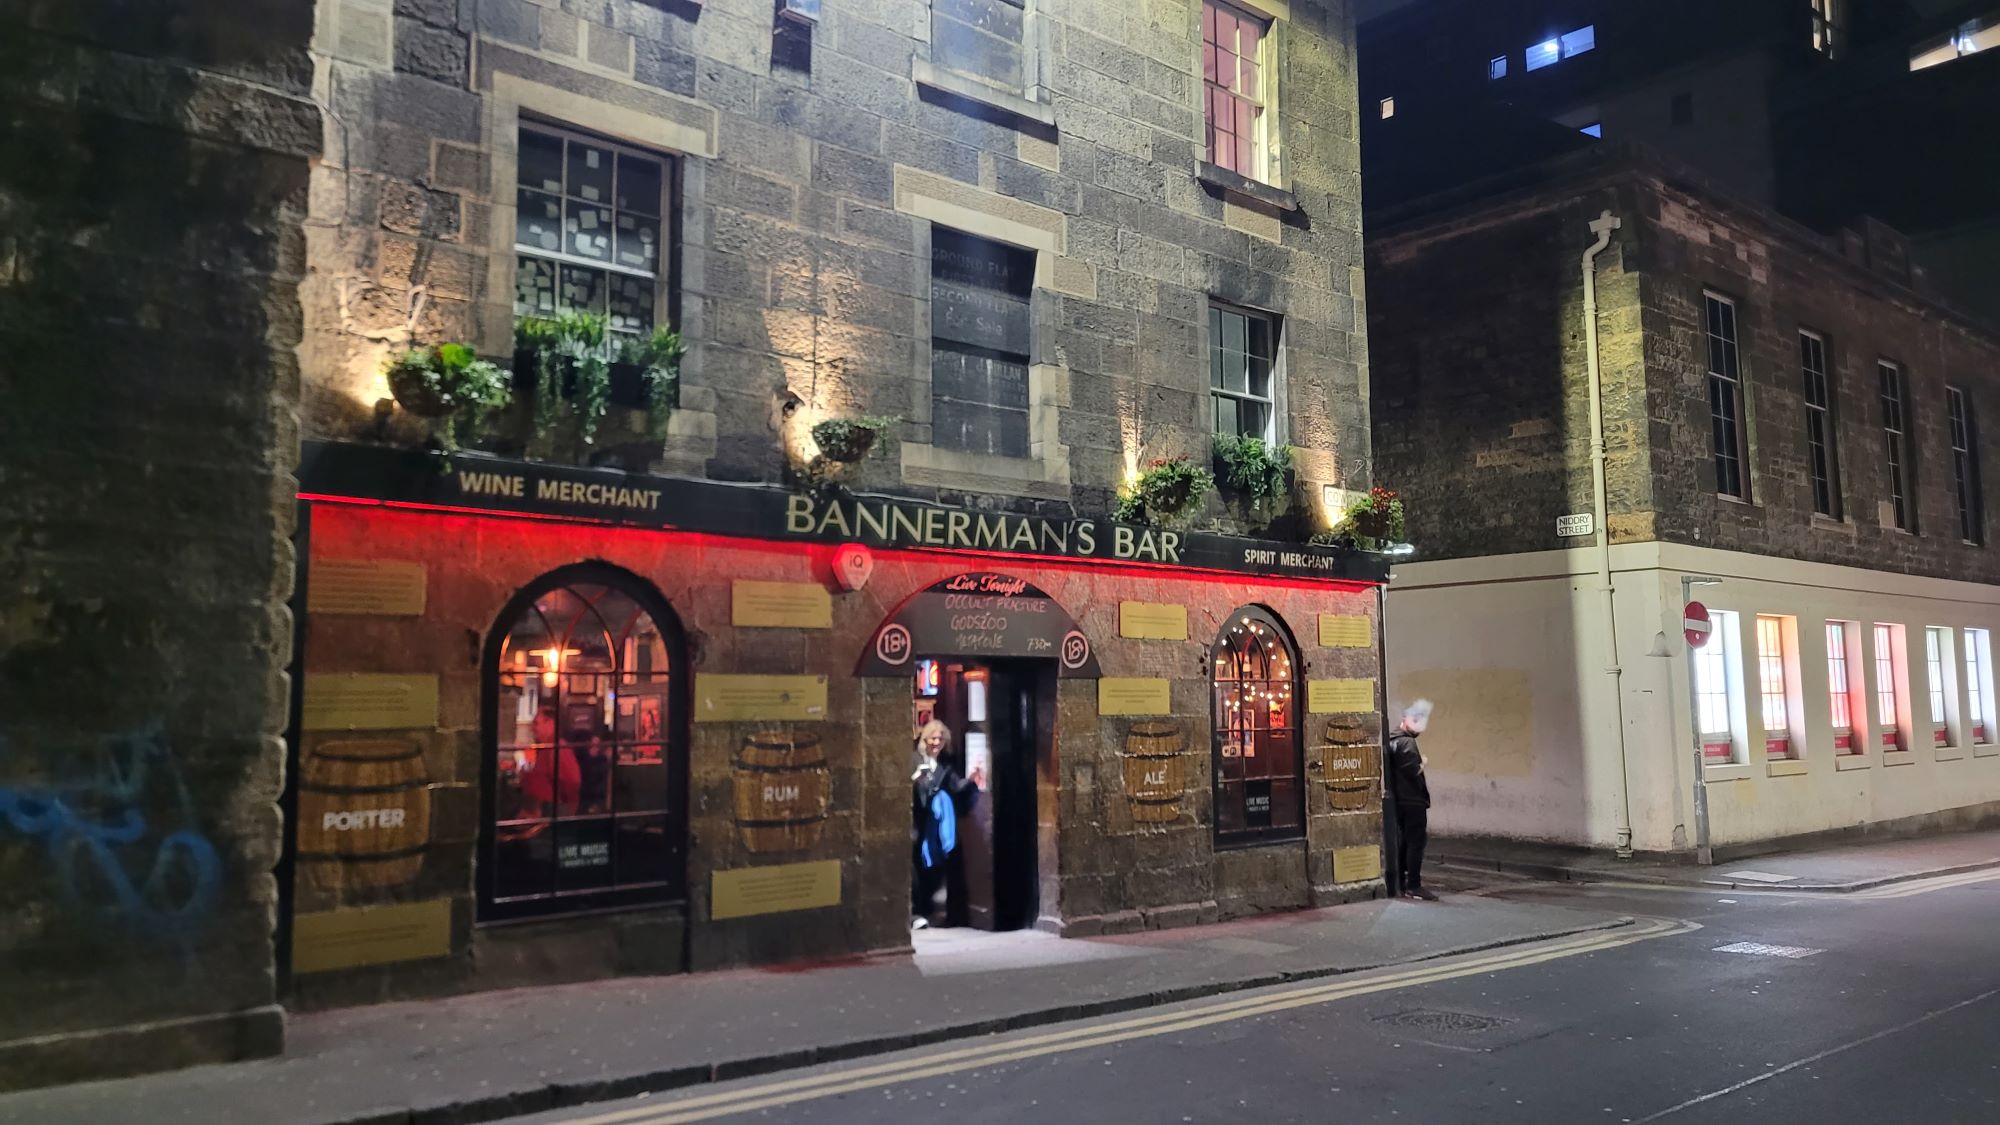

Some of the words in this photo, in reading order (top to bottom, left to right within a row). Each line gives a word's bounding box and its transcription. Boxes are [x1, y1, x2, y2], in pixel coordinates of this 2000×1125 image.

[460, 471, 525, 497] WINE
[538, 479, 661, 511] MERCHANT
[786, 494, 1096, 556] BANNERMAN'S
[1115, 527, 1182, 564] BAR
[1559, 515, 1590, 526] NIDDRY
[1559, 525, 1589, 535] STREET
[1244, 549, 1276, 565] SPIRIT
[1281, 552, 1335, 570] MERCHANT
[946, 575, 978, 591] Live
[980, 575, 1026, 597] Tonight
[1333, 758, 1362, 770] BRANDY
[1143, 771, 1165, 786] ALE
[764, 785, 799, 802] RUM
[323, 809, 405, 831] PORTER
